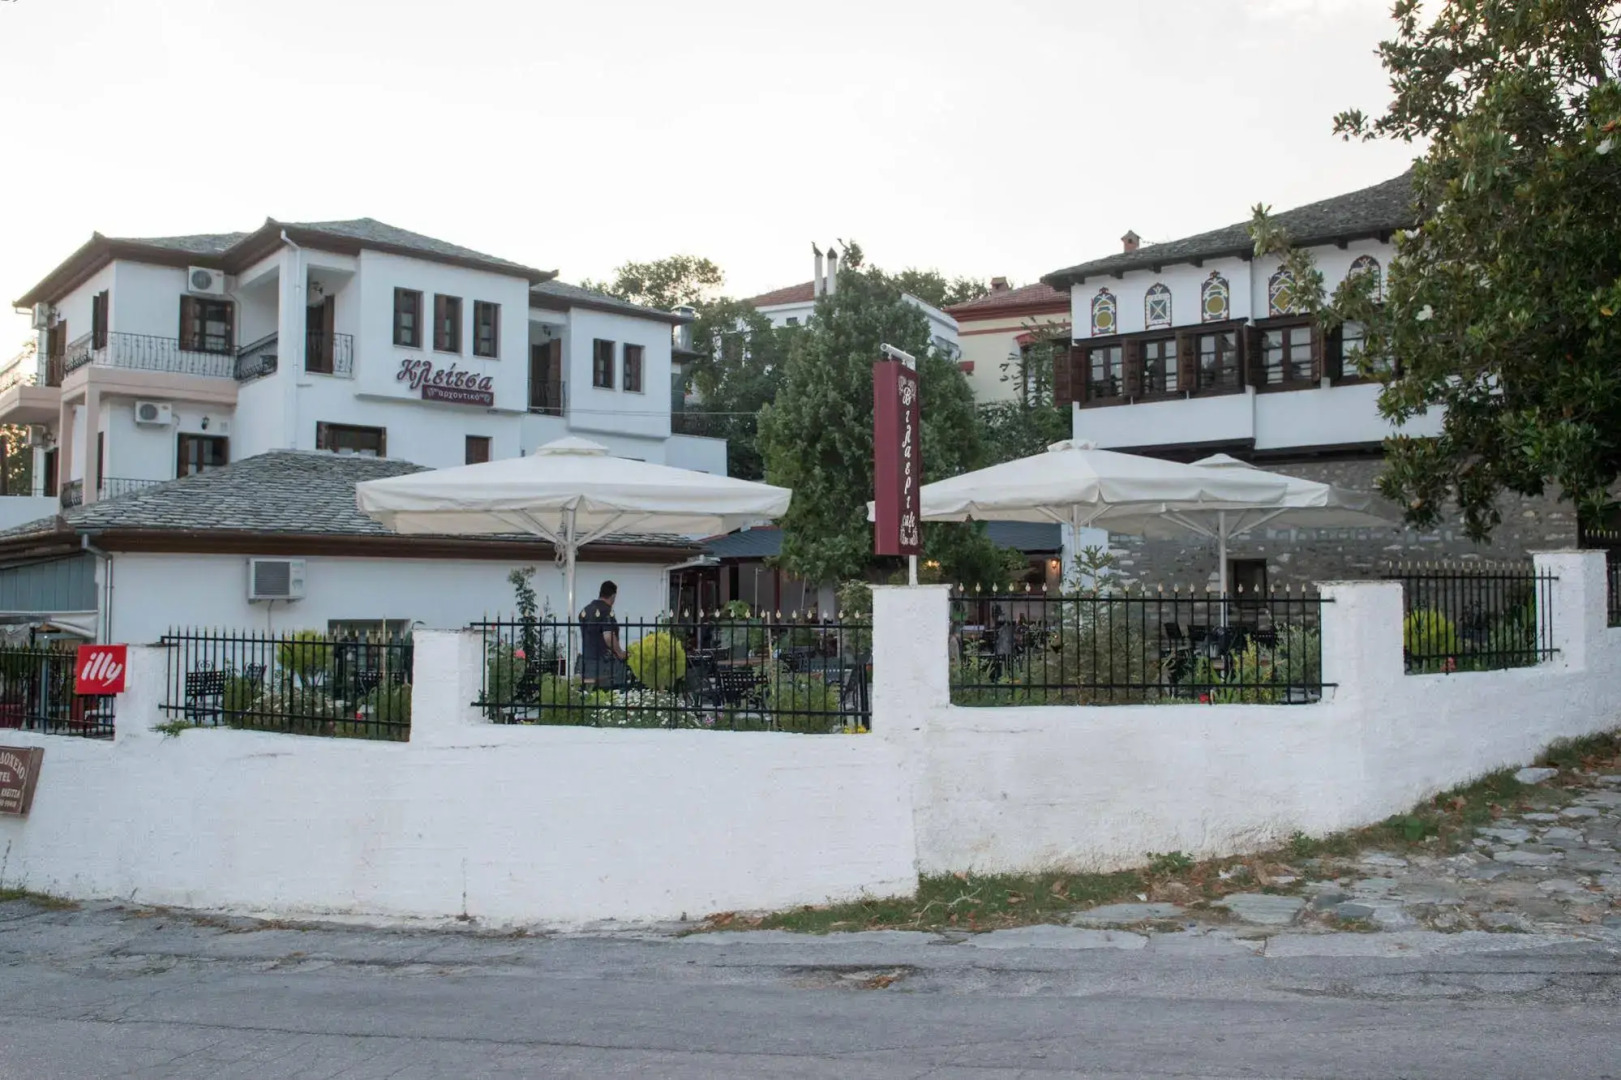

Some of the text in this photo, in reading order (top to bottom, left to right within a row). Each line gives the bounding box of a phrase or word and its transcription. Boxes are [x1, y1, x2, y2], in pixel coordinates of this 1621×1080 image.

[397, 359, 493, 391] Κλείτσα
[438, 390, 480, 401] αρχοντικό
[81, 652, 123, 687] illy
